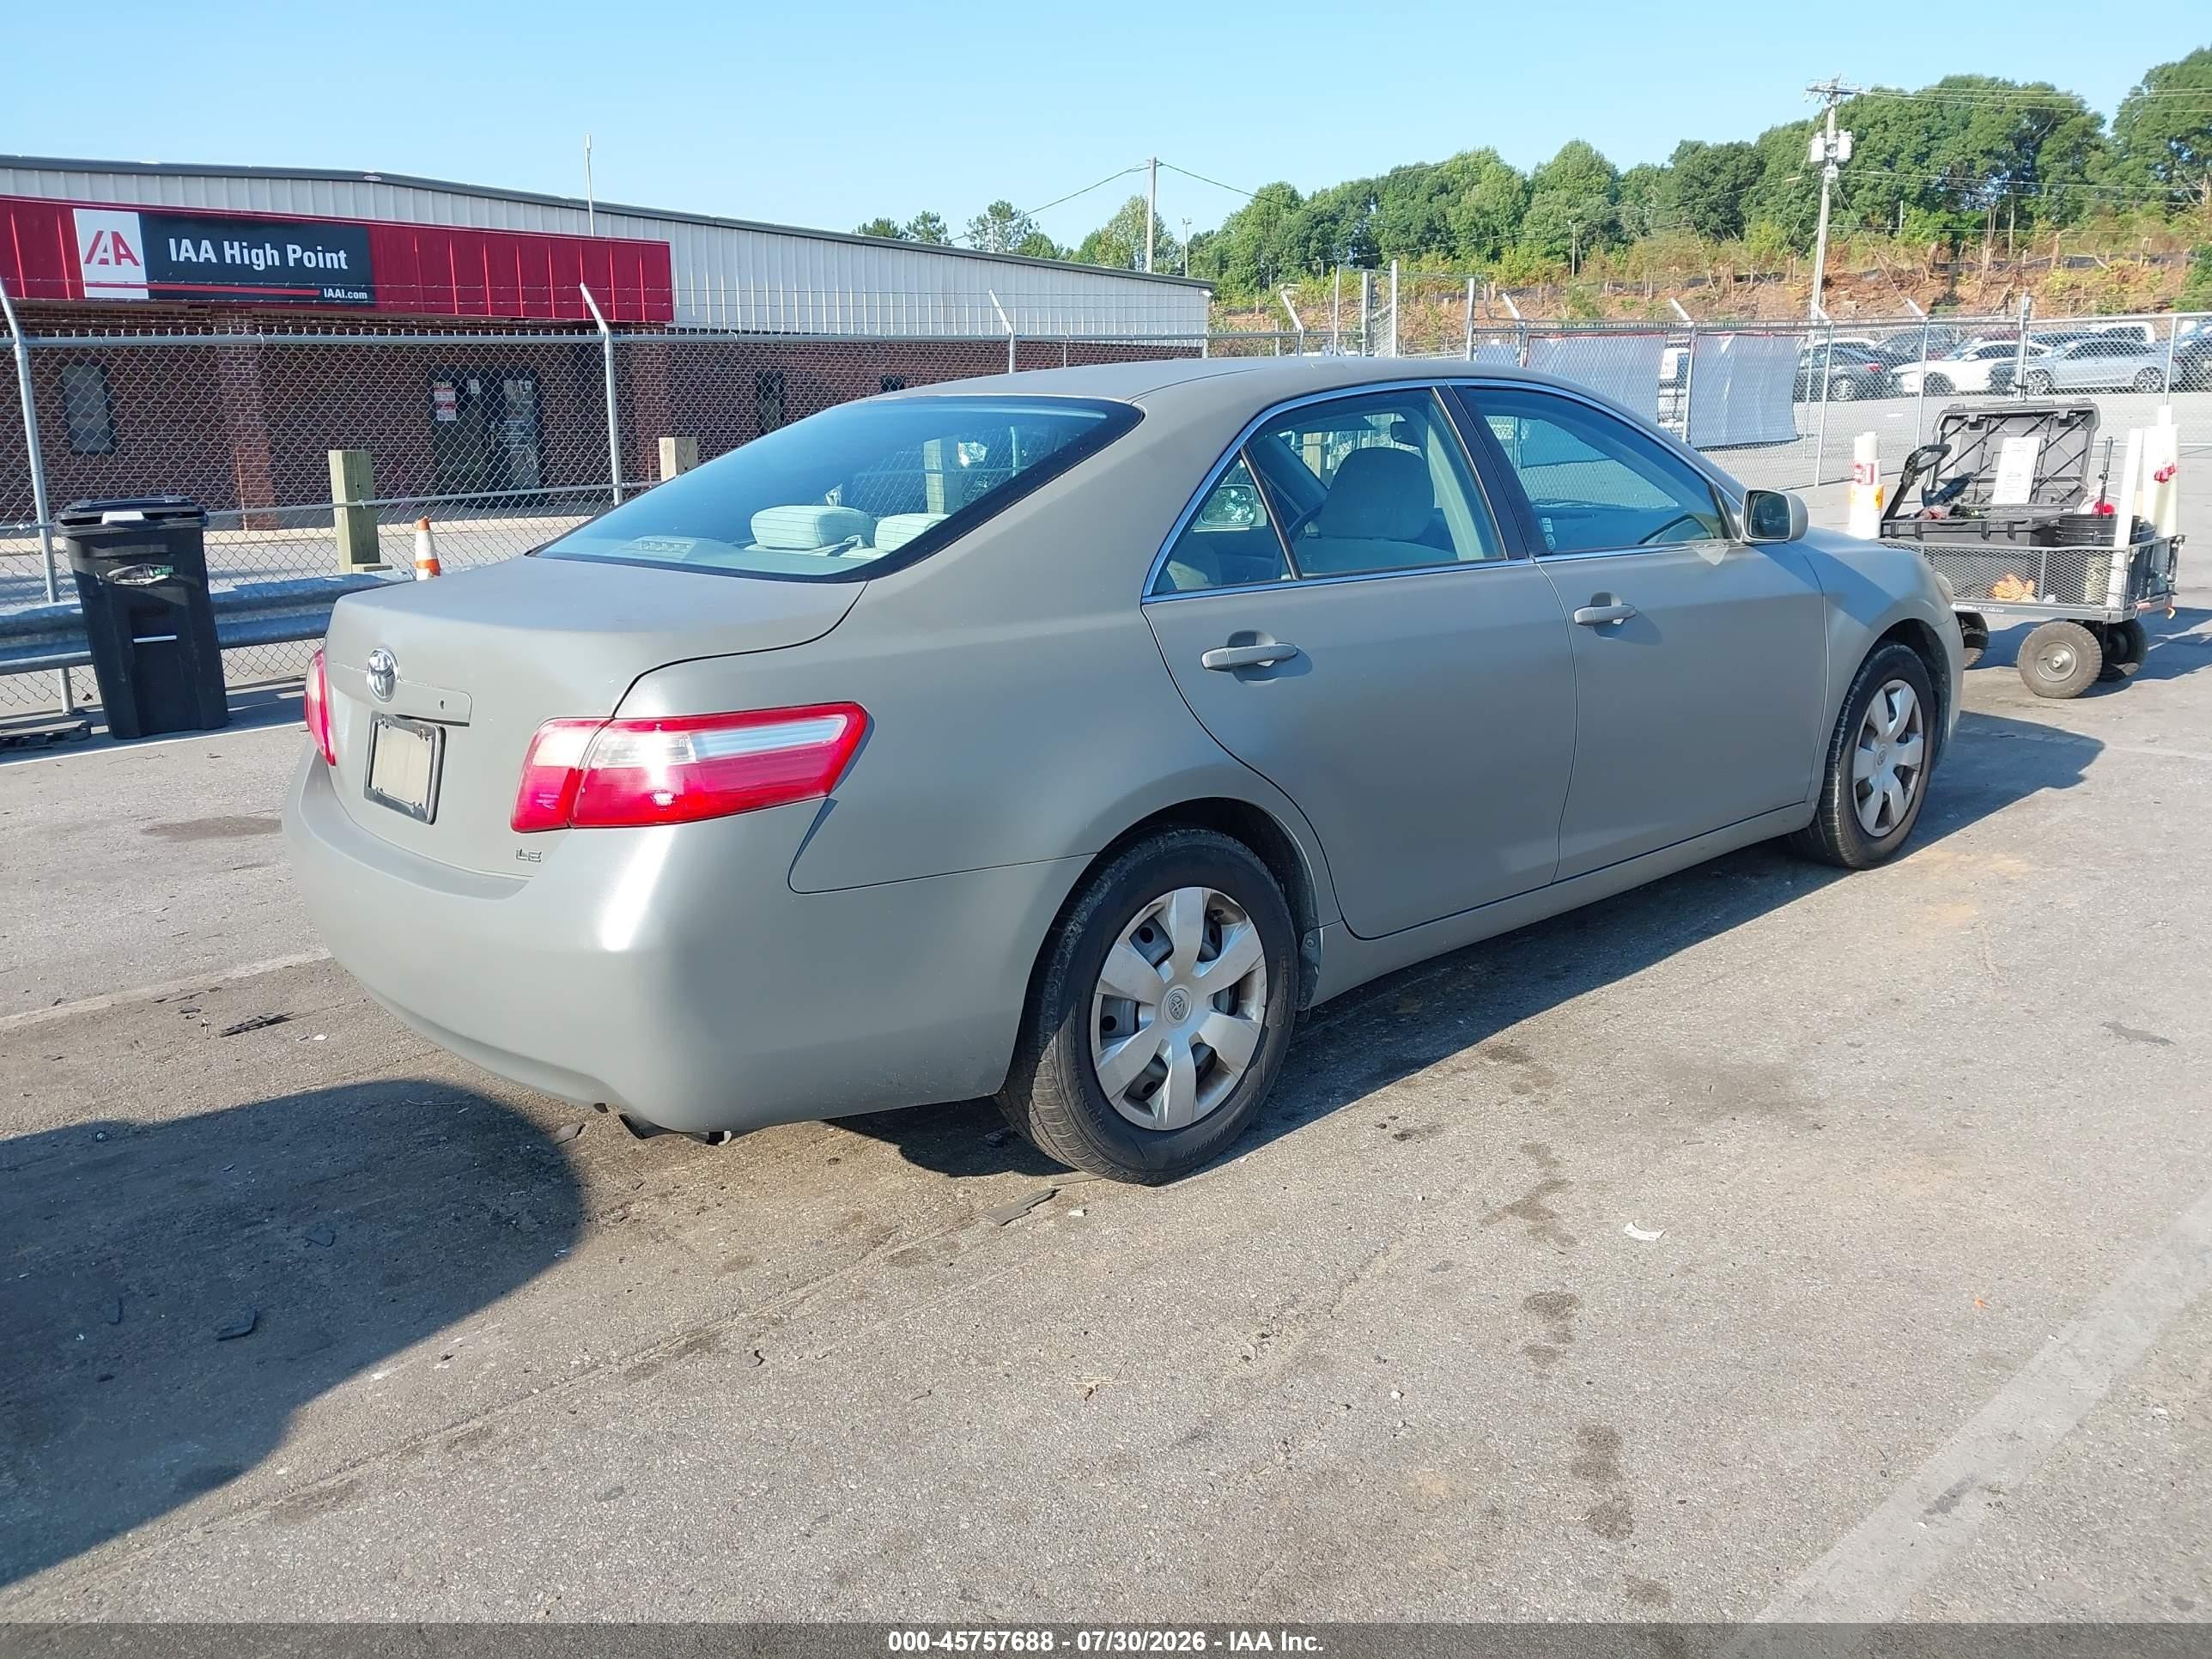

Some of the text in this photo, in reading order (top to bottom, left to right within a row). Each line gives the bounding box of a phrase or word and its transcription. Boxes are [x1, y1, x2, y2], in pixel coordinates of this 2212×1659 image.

[168, 237, 349, 271] IAA High Point
[515, 848, 542, 863] LE
